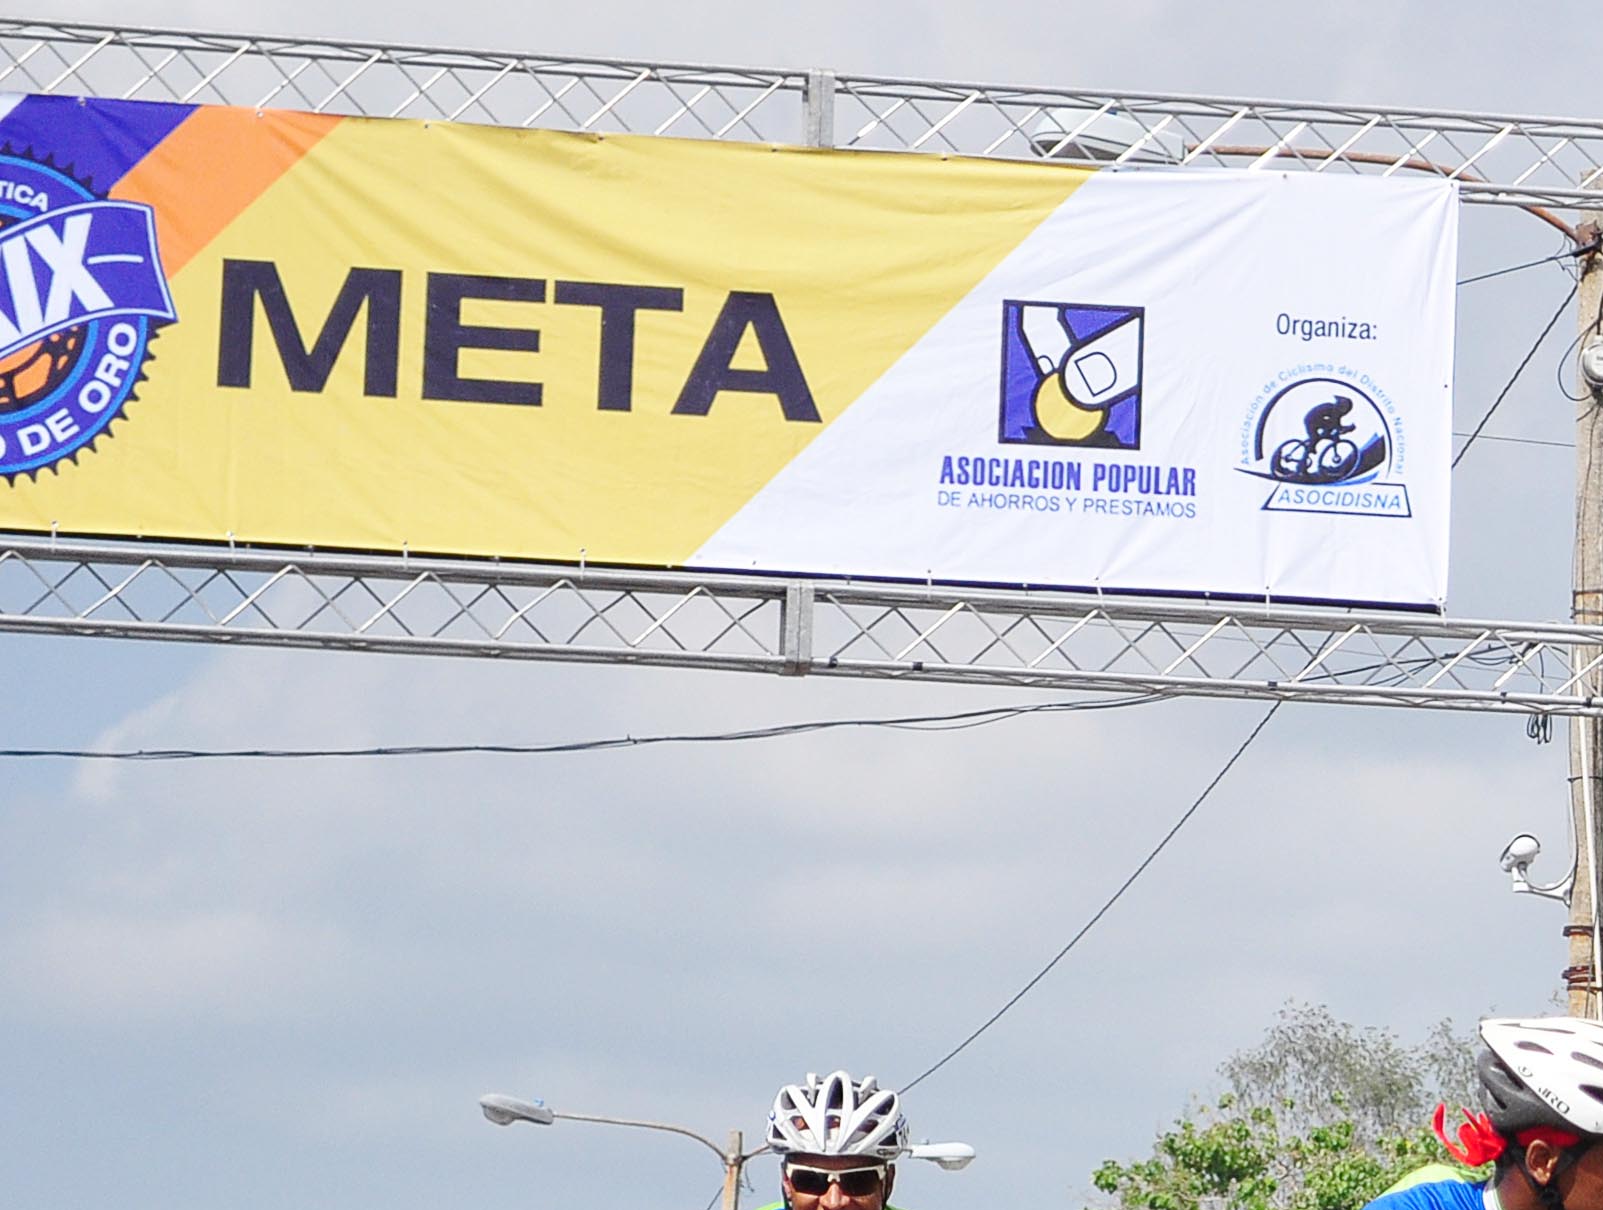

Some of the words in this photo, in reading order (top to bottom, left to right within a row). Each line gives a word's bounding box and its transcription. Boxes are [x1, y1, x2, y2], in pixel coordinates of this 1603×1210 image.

[0, 212, 115, 350] IX
[217, 258, 823, 424] META
[1276, 313, 1377, 342] Organiza:
[17, 407, 80, 456] DE
[78, 322, 138, 414] ORO
[1278, 363, 1335, 382] Ciclismo
[1338, 364, 1358, 379] del
[1360, 374, 1396, 415] Distrito
[940, 455, 1082, 491] ASOCIACION
[1093, 463, 1197, 496] POPULAR
[938, 491, 961, 507] DE
[967, 493, 1060, 512] AHORROS
[1066, 497, 1078, 512] Y
[1083, 498, 1197, 518] PRESTAMOS
[1278, 489, 1401, 510] ASOCIDISNA
